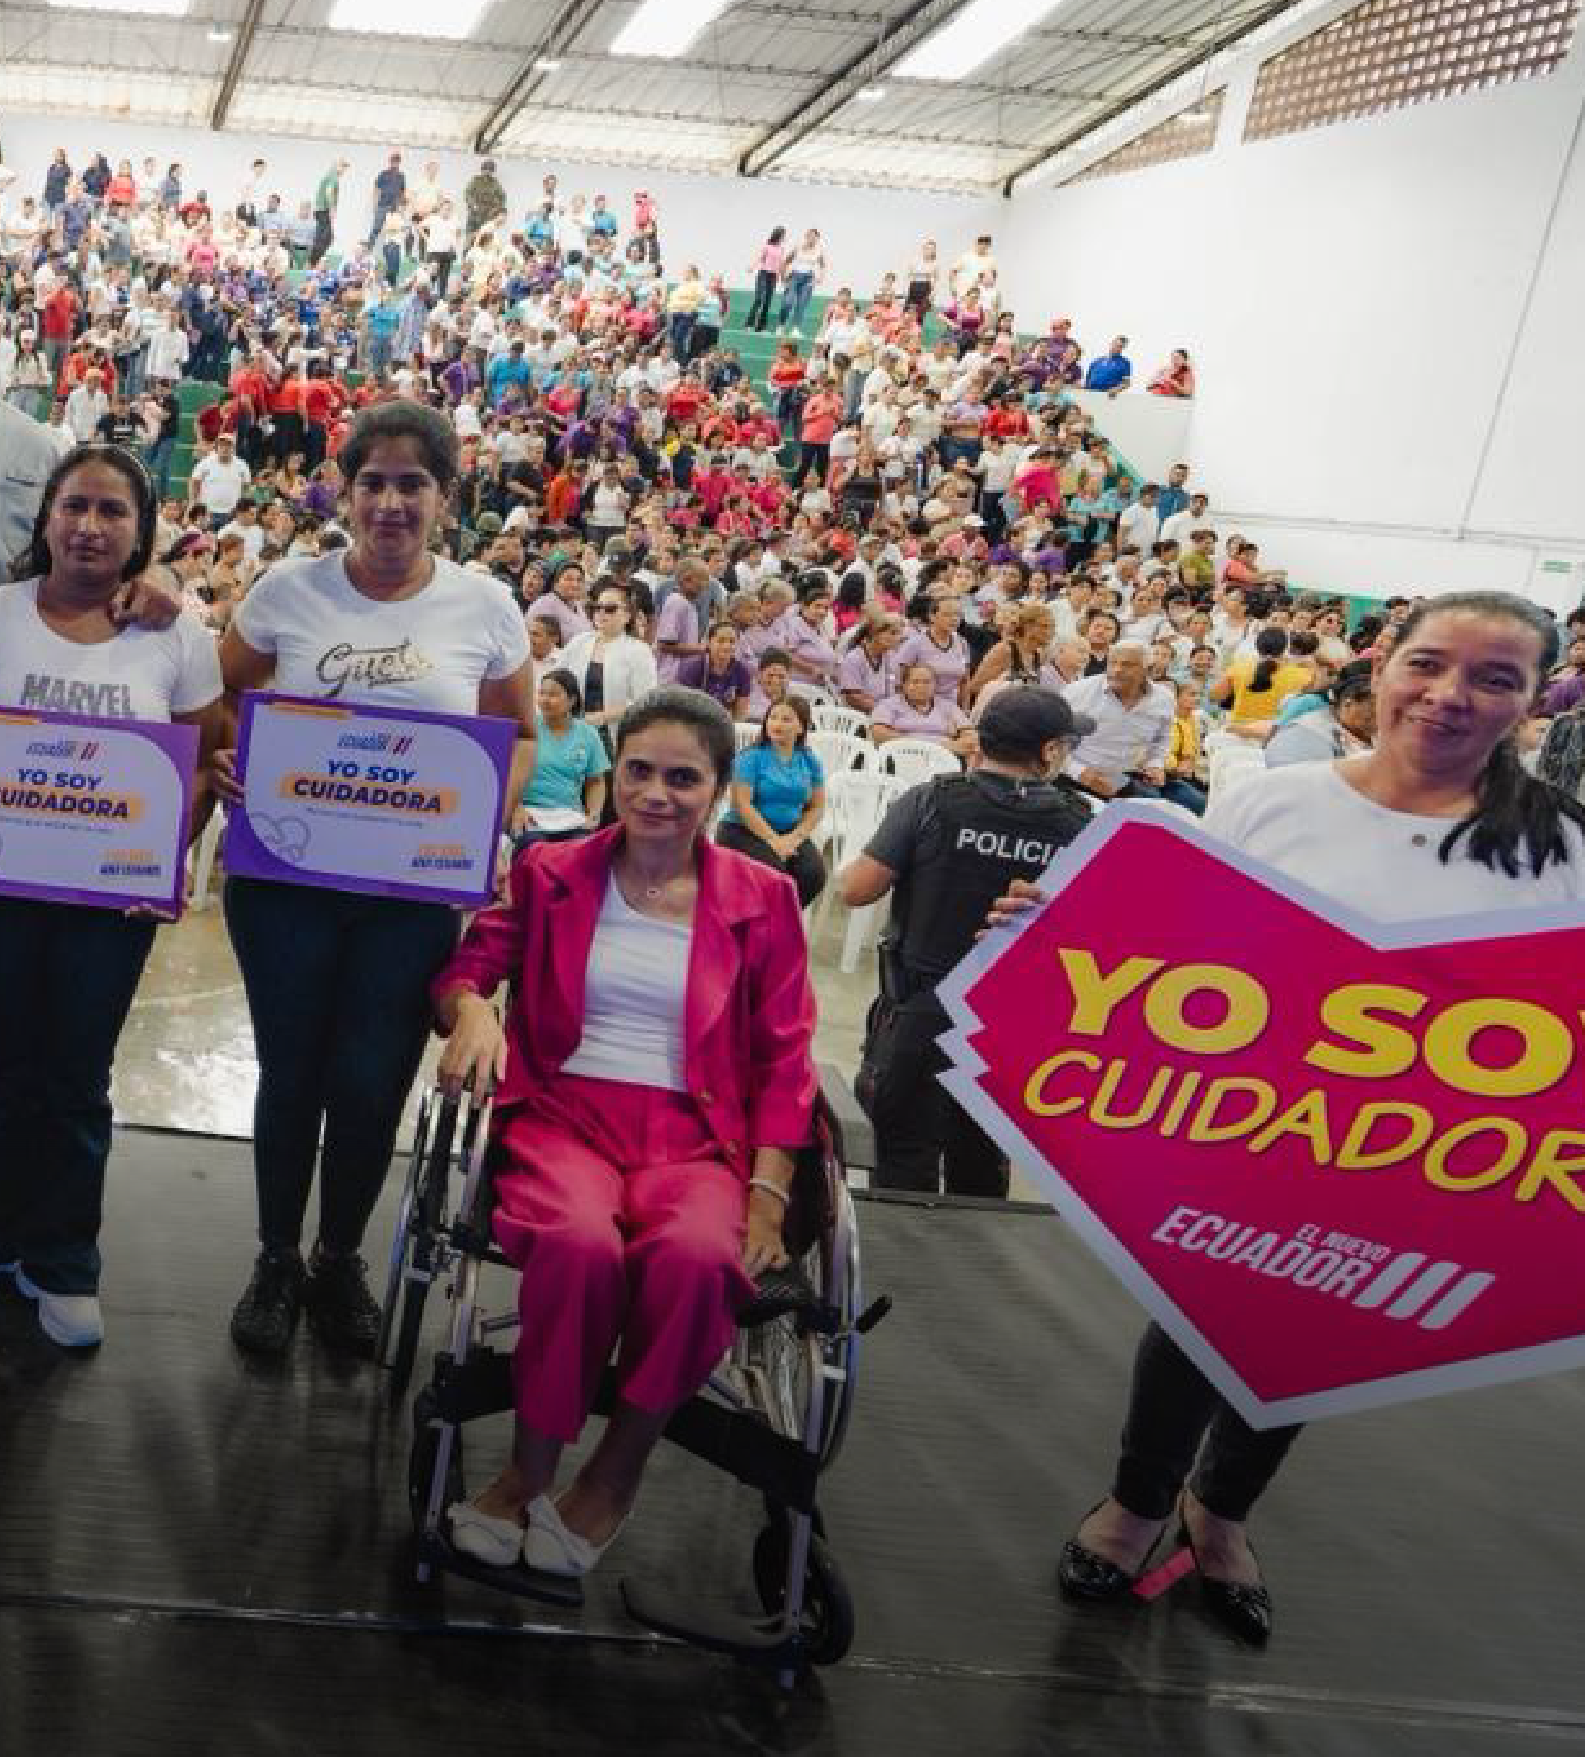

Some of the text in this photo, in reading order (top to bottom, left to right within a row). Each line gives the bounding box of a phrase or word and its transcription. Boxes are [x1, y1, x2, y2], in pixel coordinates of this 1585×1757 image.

[20, 674, 136, 720] MARVEL
[18, 768, 103, 792] YO SOY
[327, 760, 417, 786] YO SOY
[292, 779, 442, 814] CUIDADORA
[956, 828, 1060, 867] POLICI
[1057, 947, 1585, 1098] YO SO
[1151, 1205, 1373, 1299] ECUADOR
